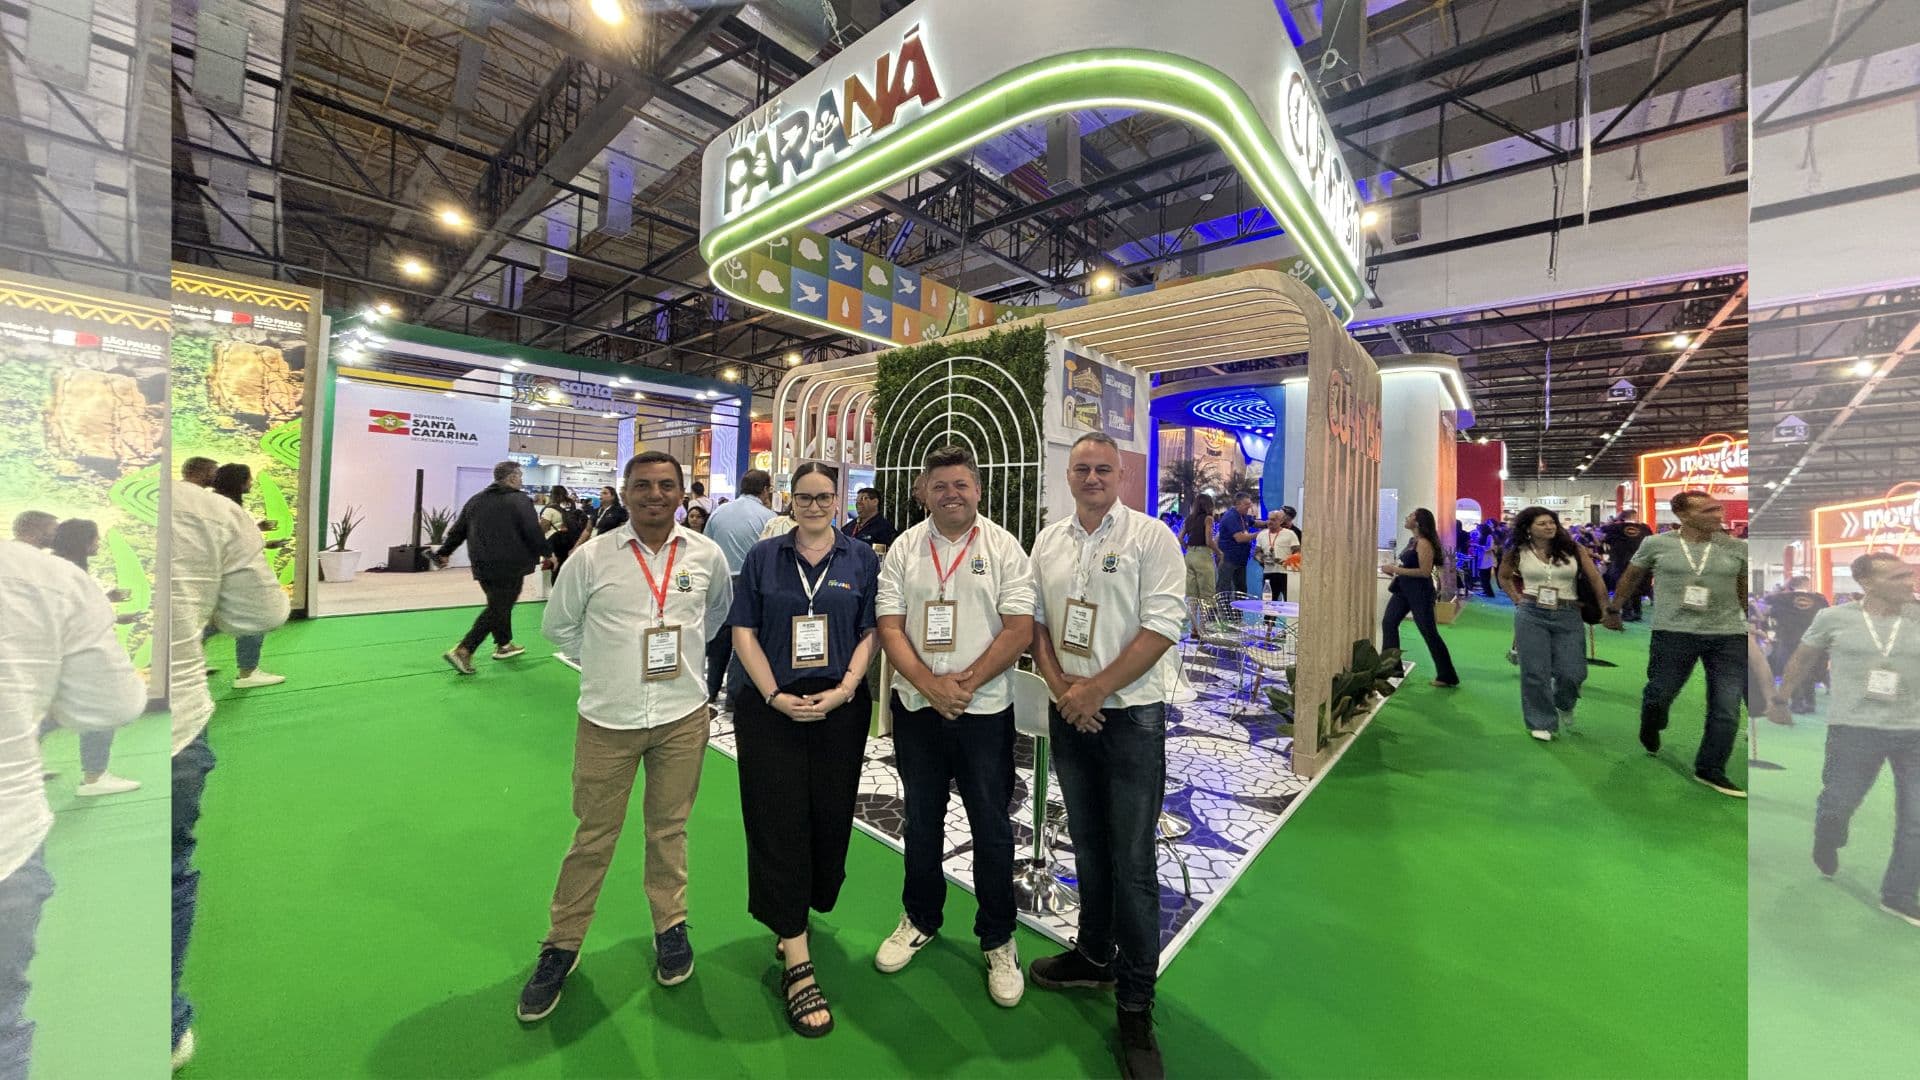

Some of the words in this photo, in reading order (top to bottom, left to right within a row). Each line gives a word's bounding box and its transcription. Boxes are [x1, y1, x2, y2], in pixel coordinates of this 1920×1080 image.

[723, 21, 943, 217] PARANÁ
[728, 98, 782, 150] VIAJE
[559, 380, 612, 399] santa
[411, 419, 457, 431] SANTA
[413, 413, 445, 421] GOVERNO
[411, 428, 479, 442] CATARINA
